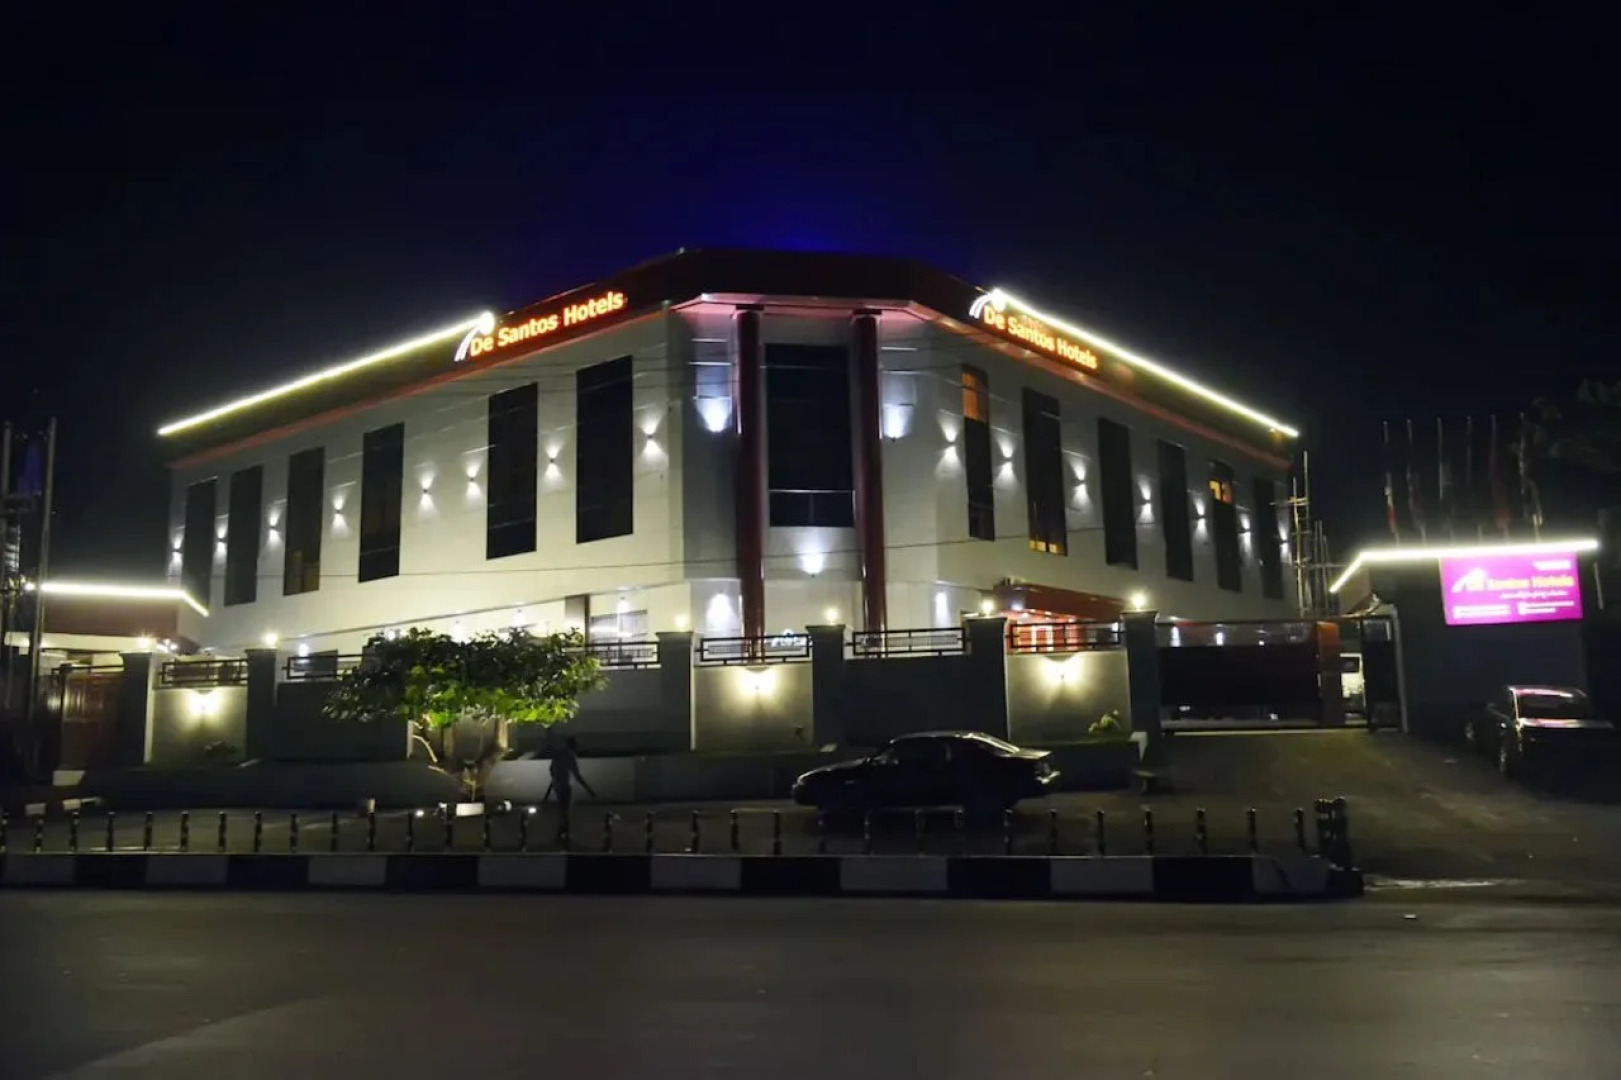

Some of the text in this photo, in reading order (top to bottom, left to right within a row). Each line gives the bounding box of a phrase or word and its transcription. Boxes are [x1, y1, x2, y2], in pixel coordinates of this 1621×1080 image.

[471, 291, 623, 356] De Santos Hotels
[983, 305, 1098, 369] De Santos Hotels
